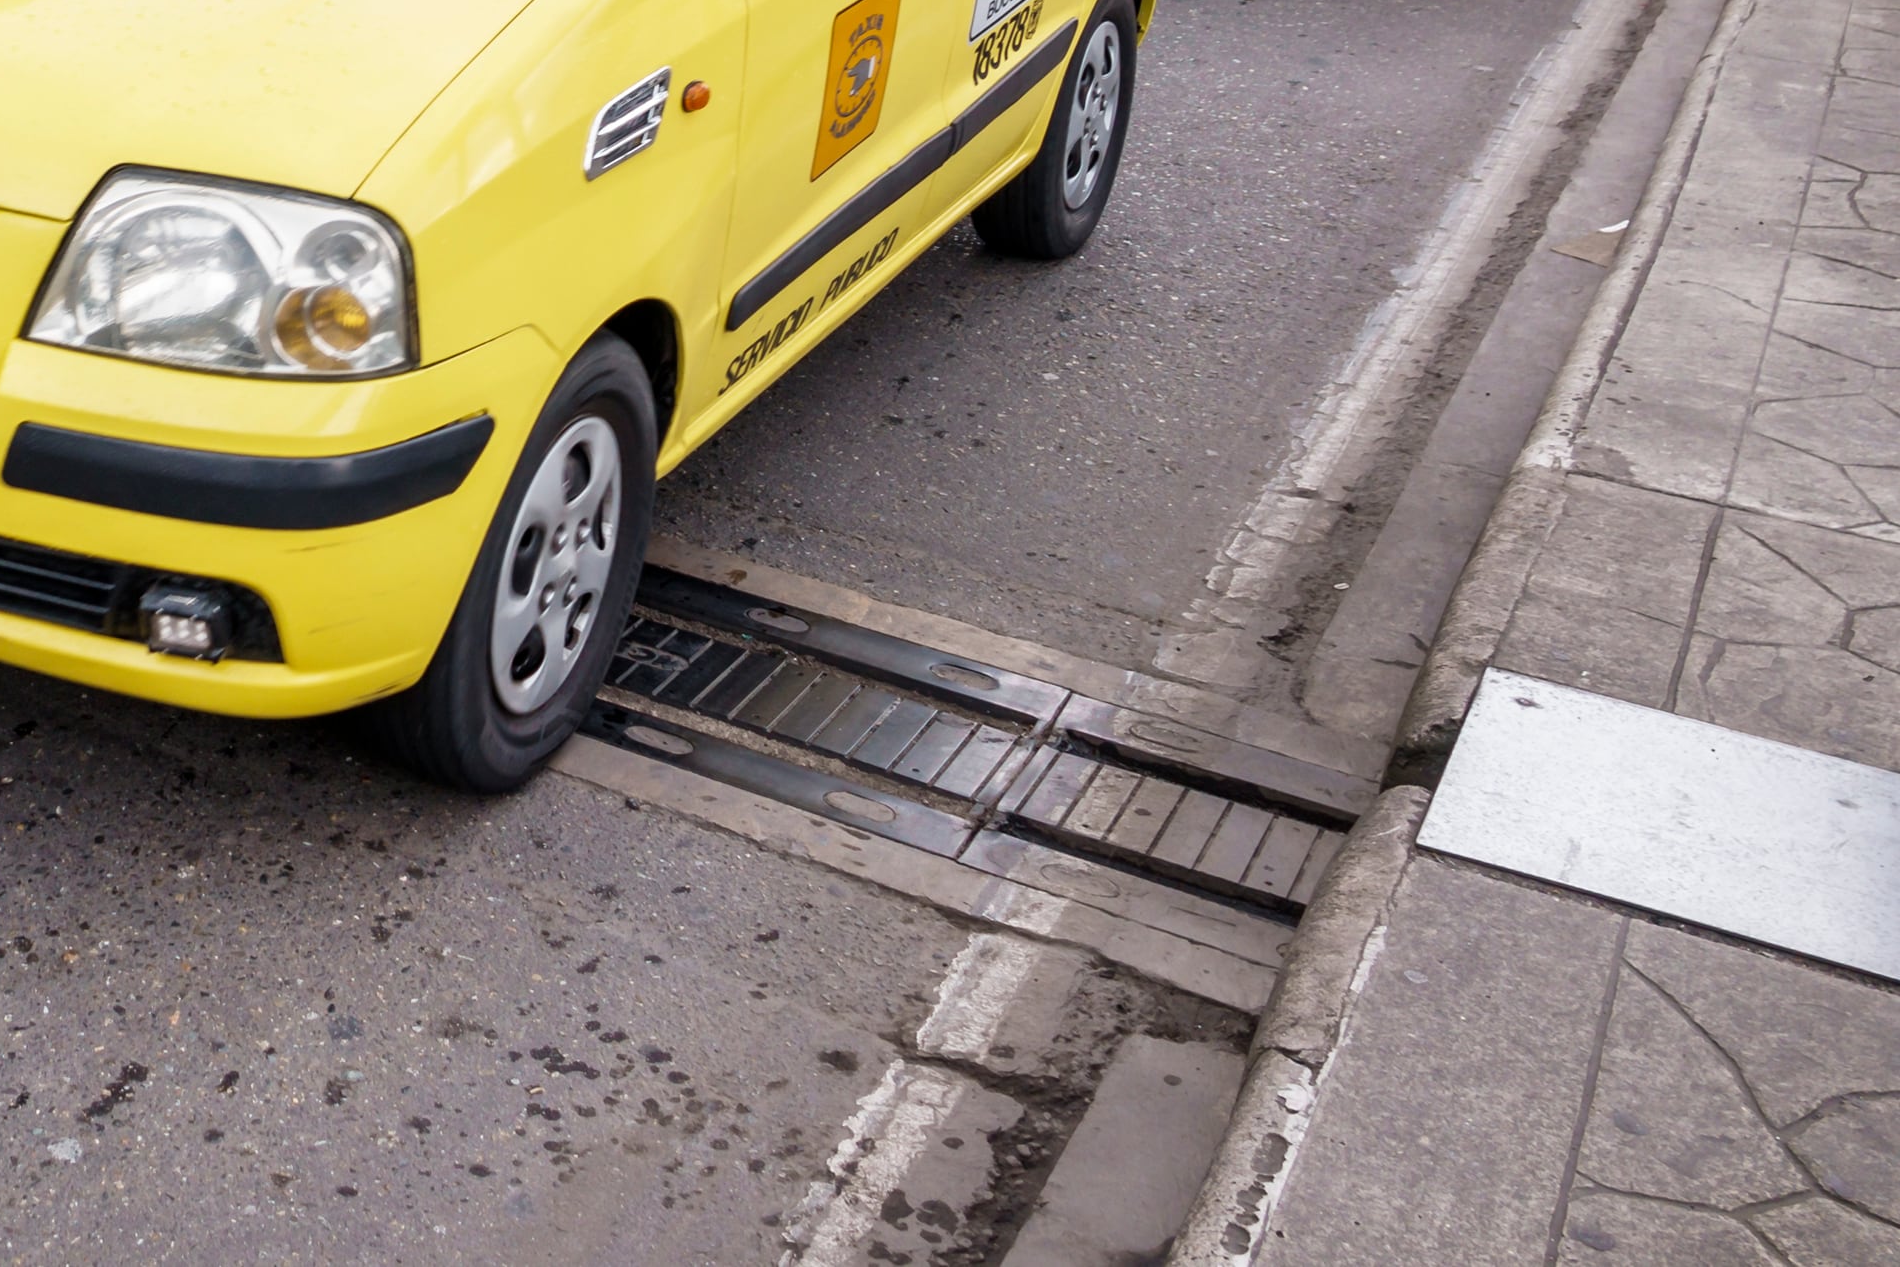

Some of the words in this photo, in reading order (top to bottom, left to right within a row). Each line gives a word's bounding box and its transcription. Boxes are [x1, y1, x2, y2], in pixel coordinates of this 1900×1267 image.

[973, 5, 1030, 86] 18378
[718, 296, 814, 398] SERVICIO
[819, 227, 899, 312] PUBLICO
